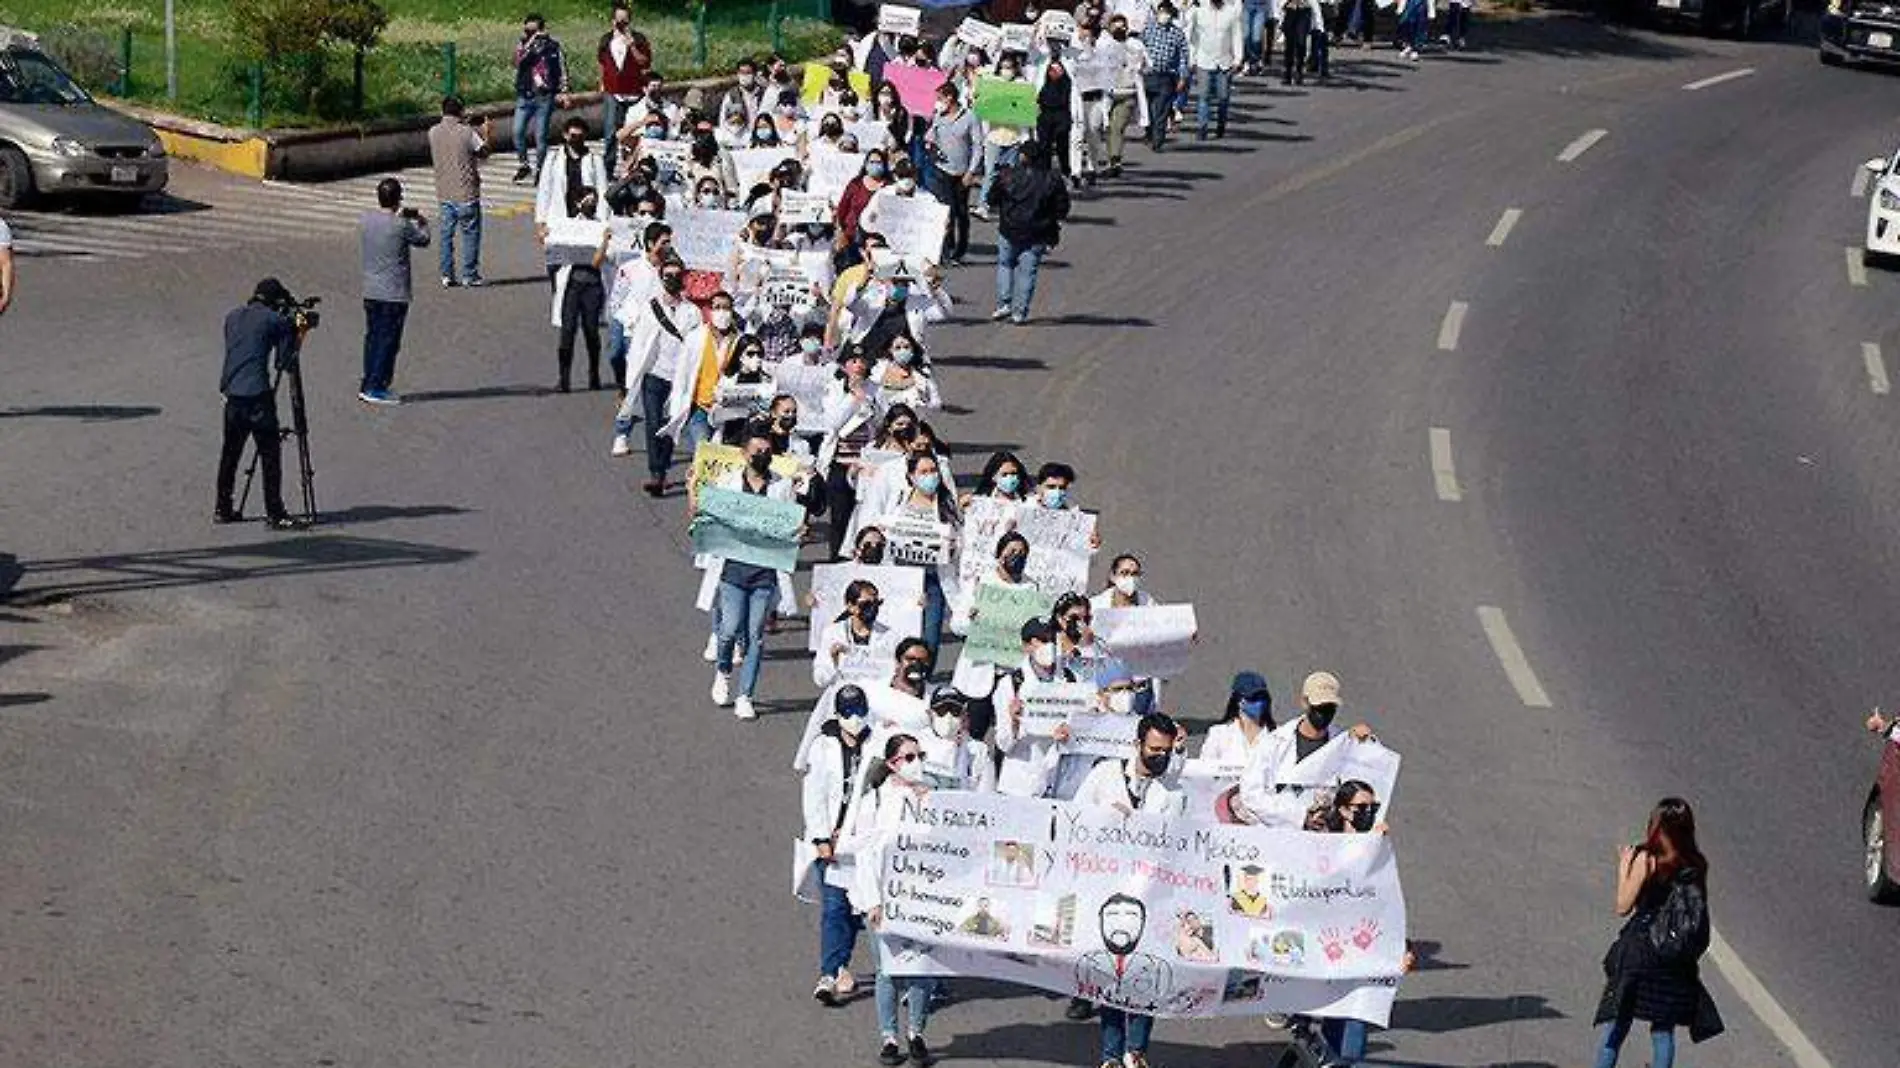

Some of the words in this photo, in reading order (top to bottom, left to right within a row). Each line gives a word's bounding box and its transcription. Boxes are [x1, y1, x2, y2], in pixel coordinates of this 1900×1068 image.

[896, 834, 918, 851] Un
[892, 855, 916, 873] Un
[918, 861, 946, 883] hijo
[888, 880, 908, 898] Un
[885, 902, 906, 920] Un
[908, 914, 955, 936] amigo
